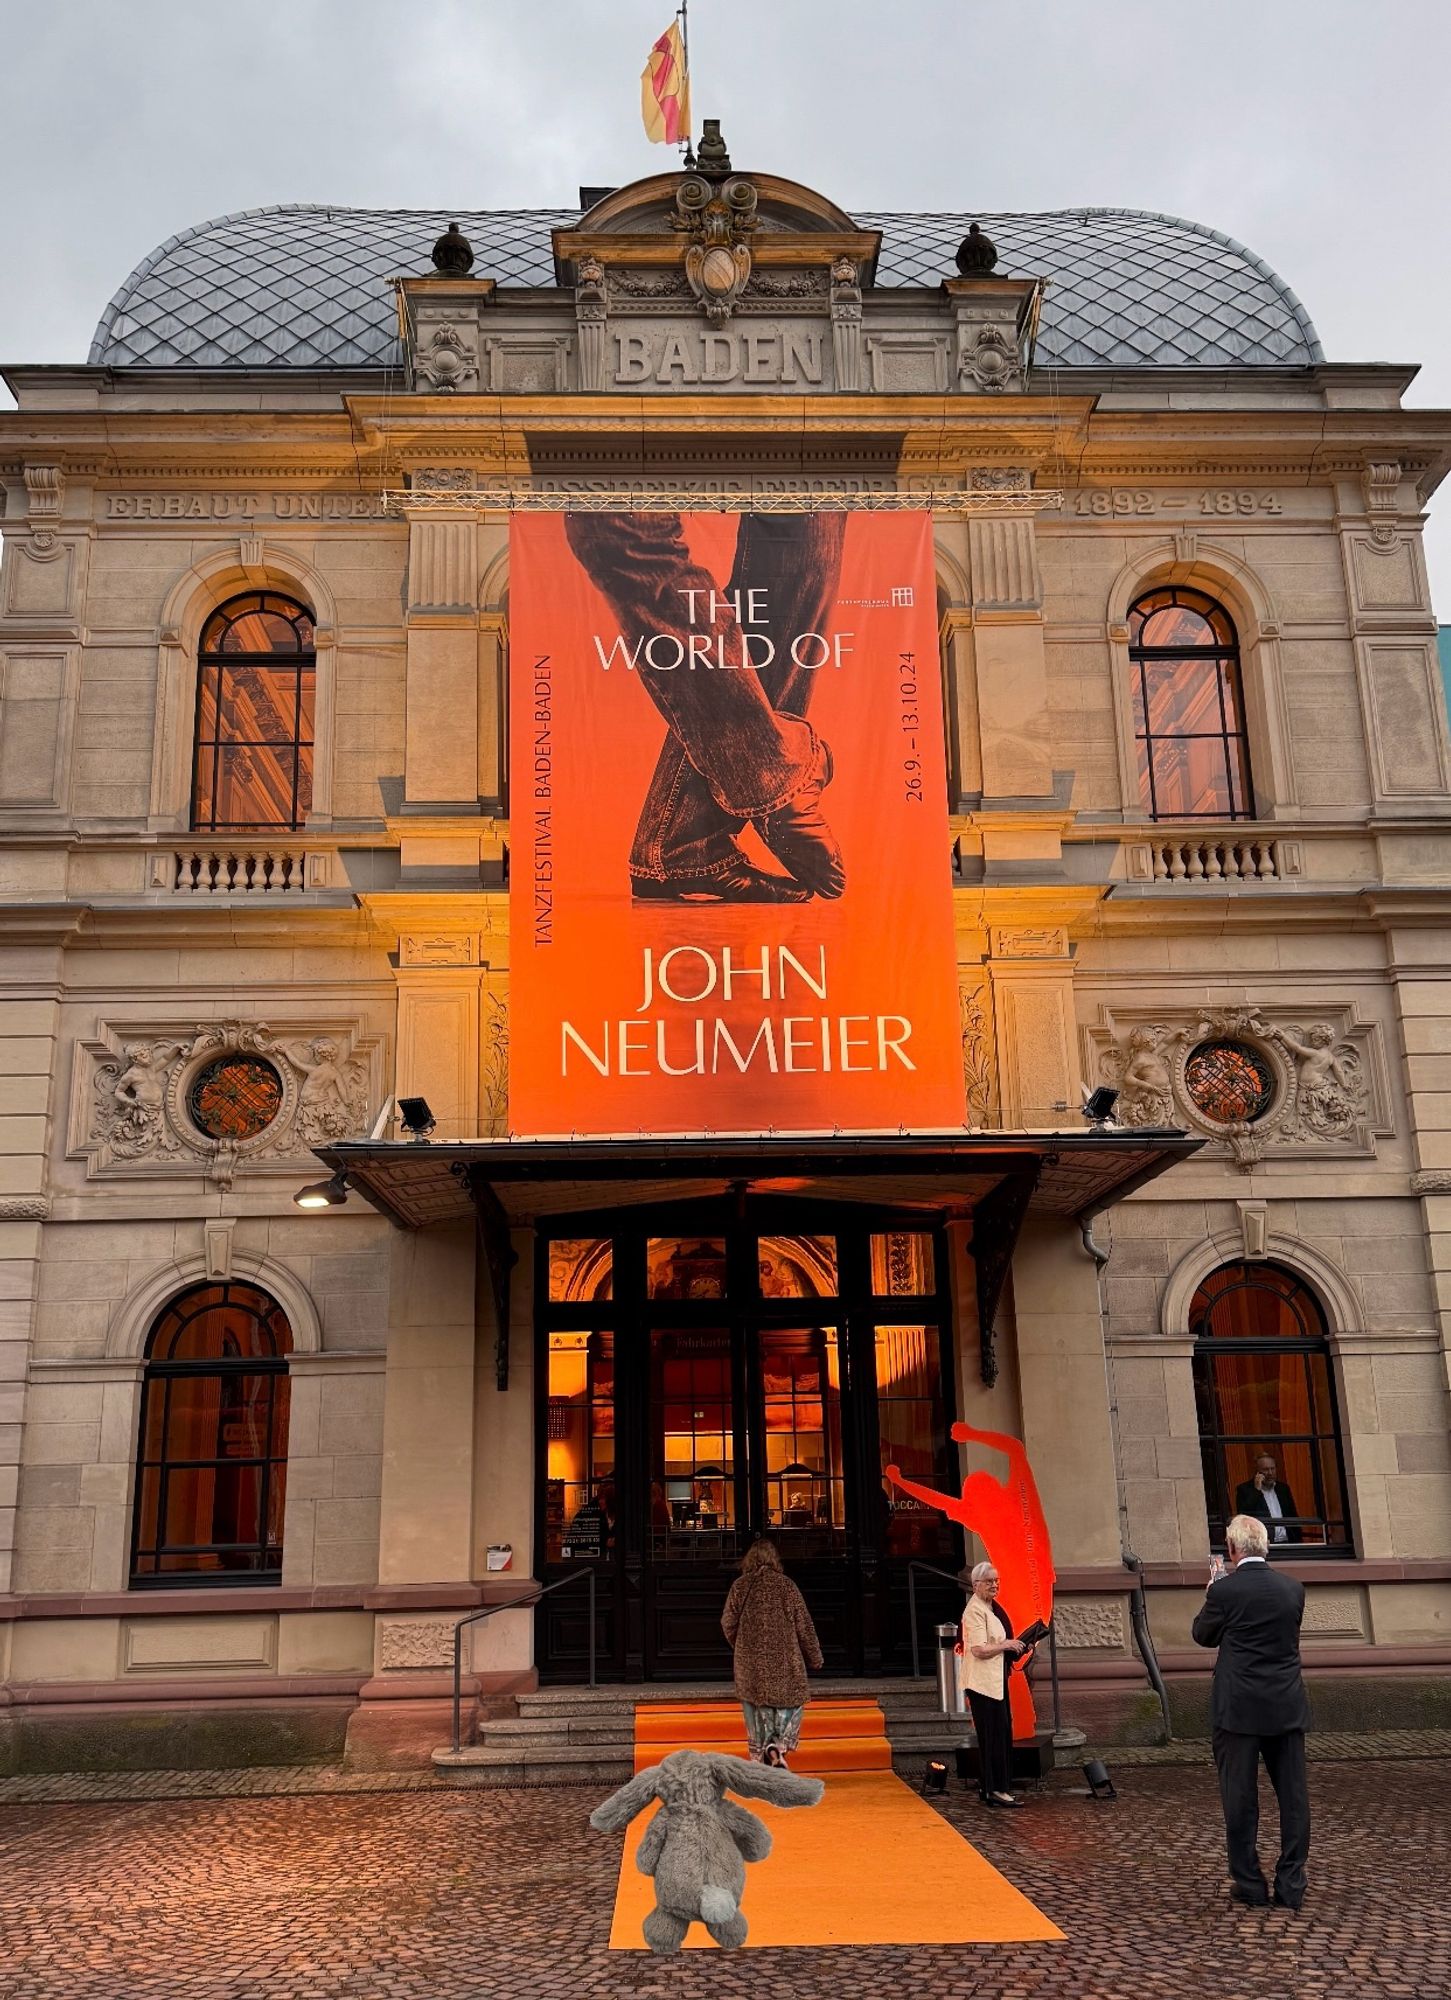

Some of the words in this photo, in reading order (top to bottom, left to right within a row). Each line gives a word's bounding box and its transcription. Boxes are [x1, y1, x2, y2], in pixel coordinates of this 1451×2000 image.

[614, 331, 823, 384] BADEN
[106, 494, 260, 519] ERBAUT
[272, 494, 400, 519] UNTER
[1074, 488, 1156, 516] 1892
[1199, 488, 1284, 515] 1894
[677, 588, 770, 625] THE
[593, 632, 776, 672] WORLD
[790, 632, 855, 669] OF
[534, 654, 552, 799] BADEN-BADEN
[534, 805, 553, 948] TANZFESTIVAL
[636, 944, 828, 1013] JOHN
[561, 1015, 918, 1077] NEUMEIER
